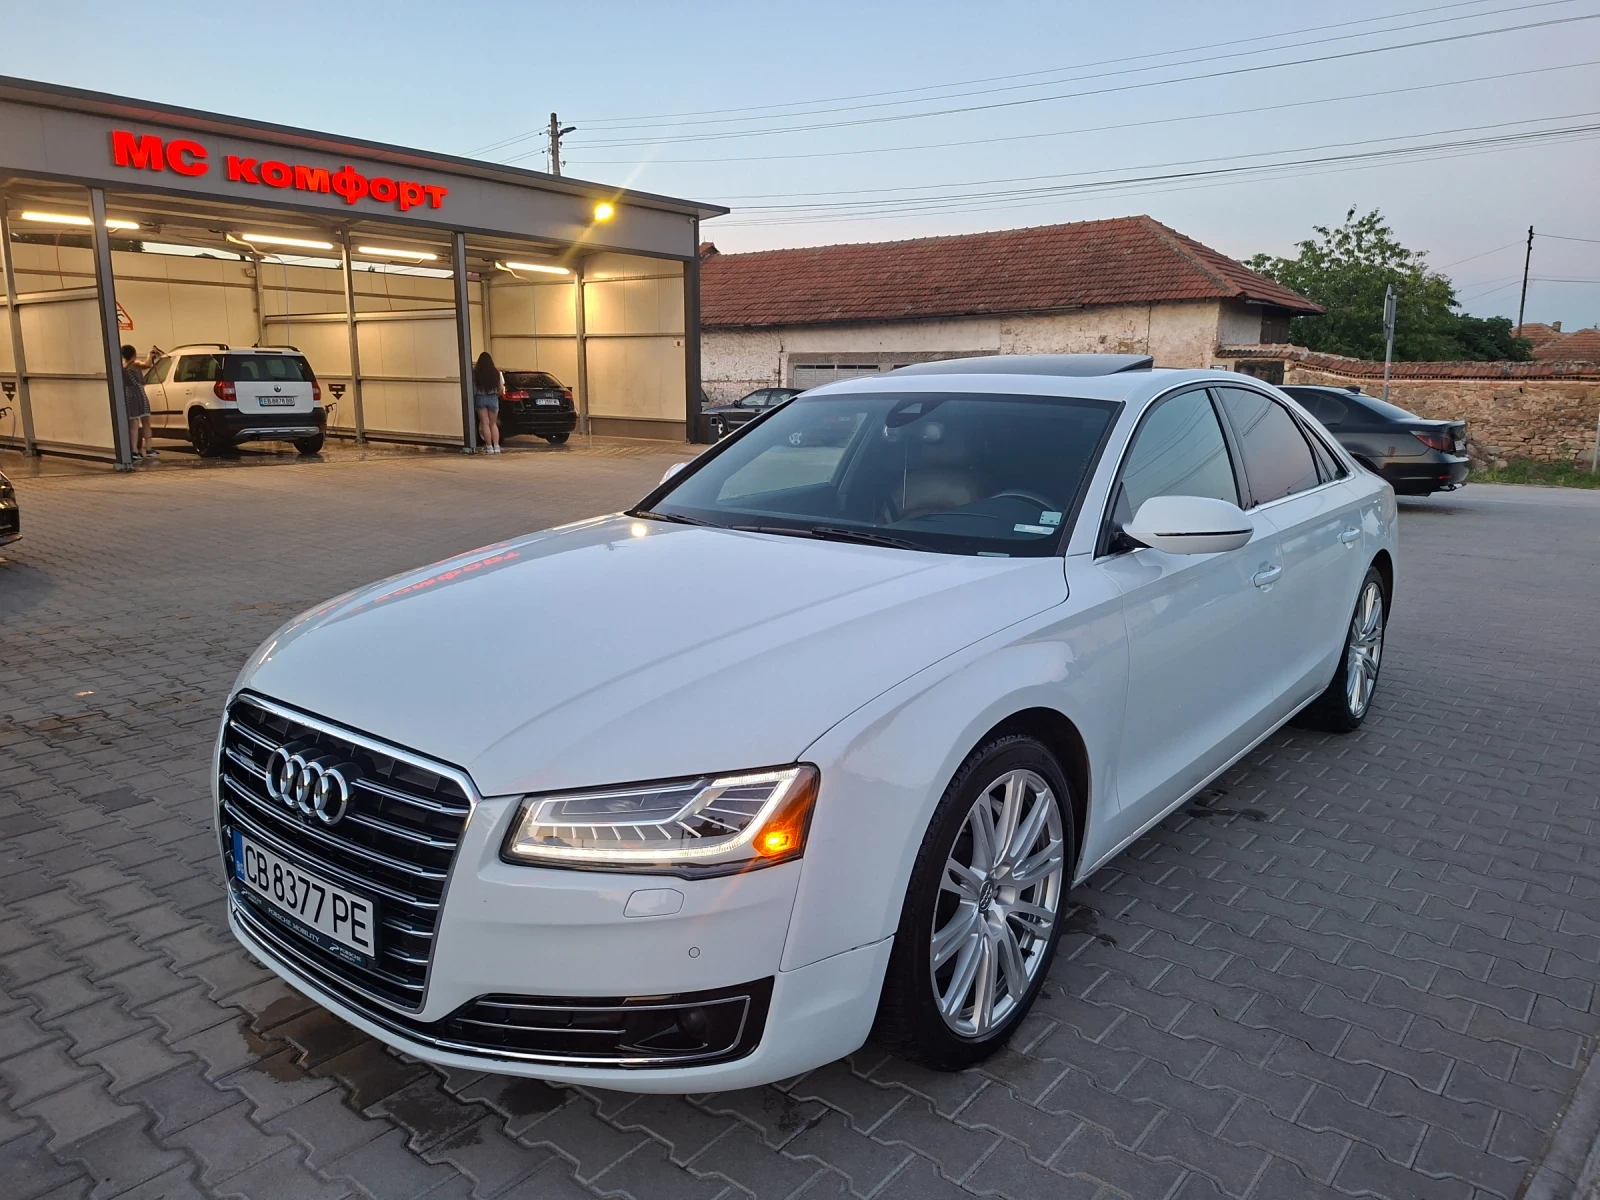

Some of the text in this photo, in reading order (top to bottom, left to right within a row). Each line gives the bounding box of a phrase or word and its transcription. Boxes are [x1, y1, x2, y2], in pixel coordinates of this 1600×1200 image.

[112, 130, 448, 212] МС комфорт
[245, 845, 369, 948] CB 8377 PE
[268, 907, 320, 943] PORSCHE MOBILITY
